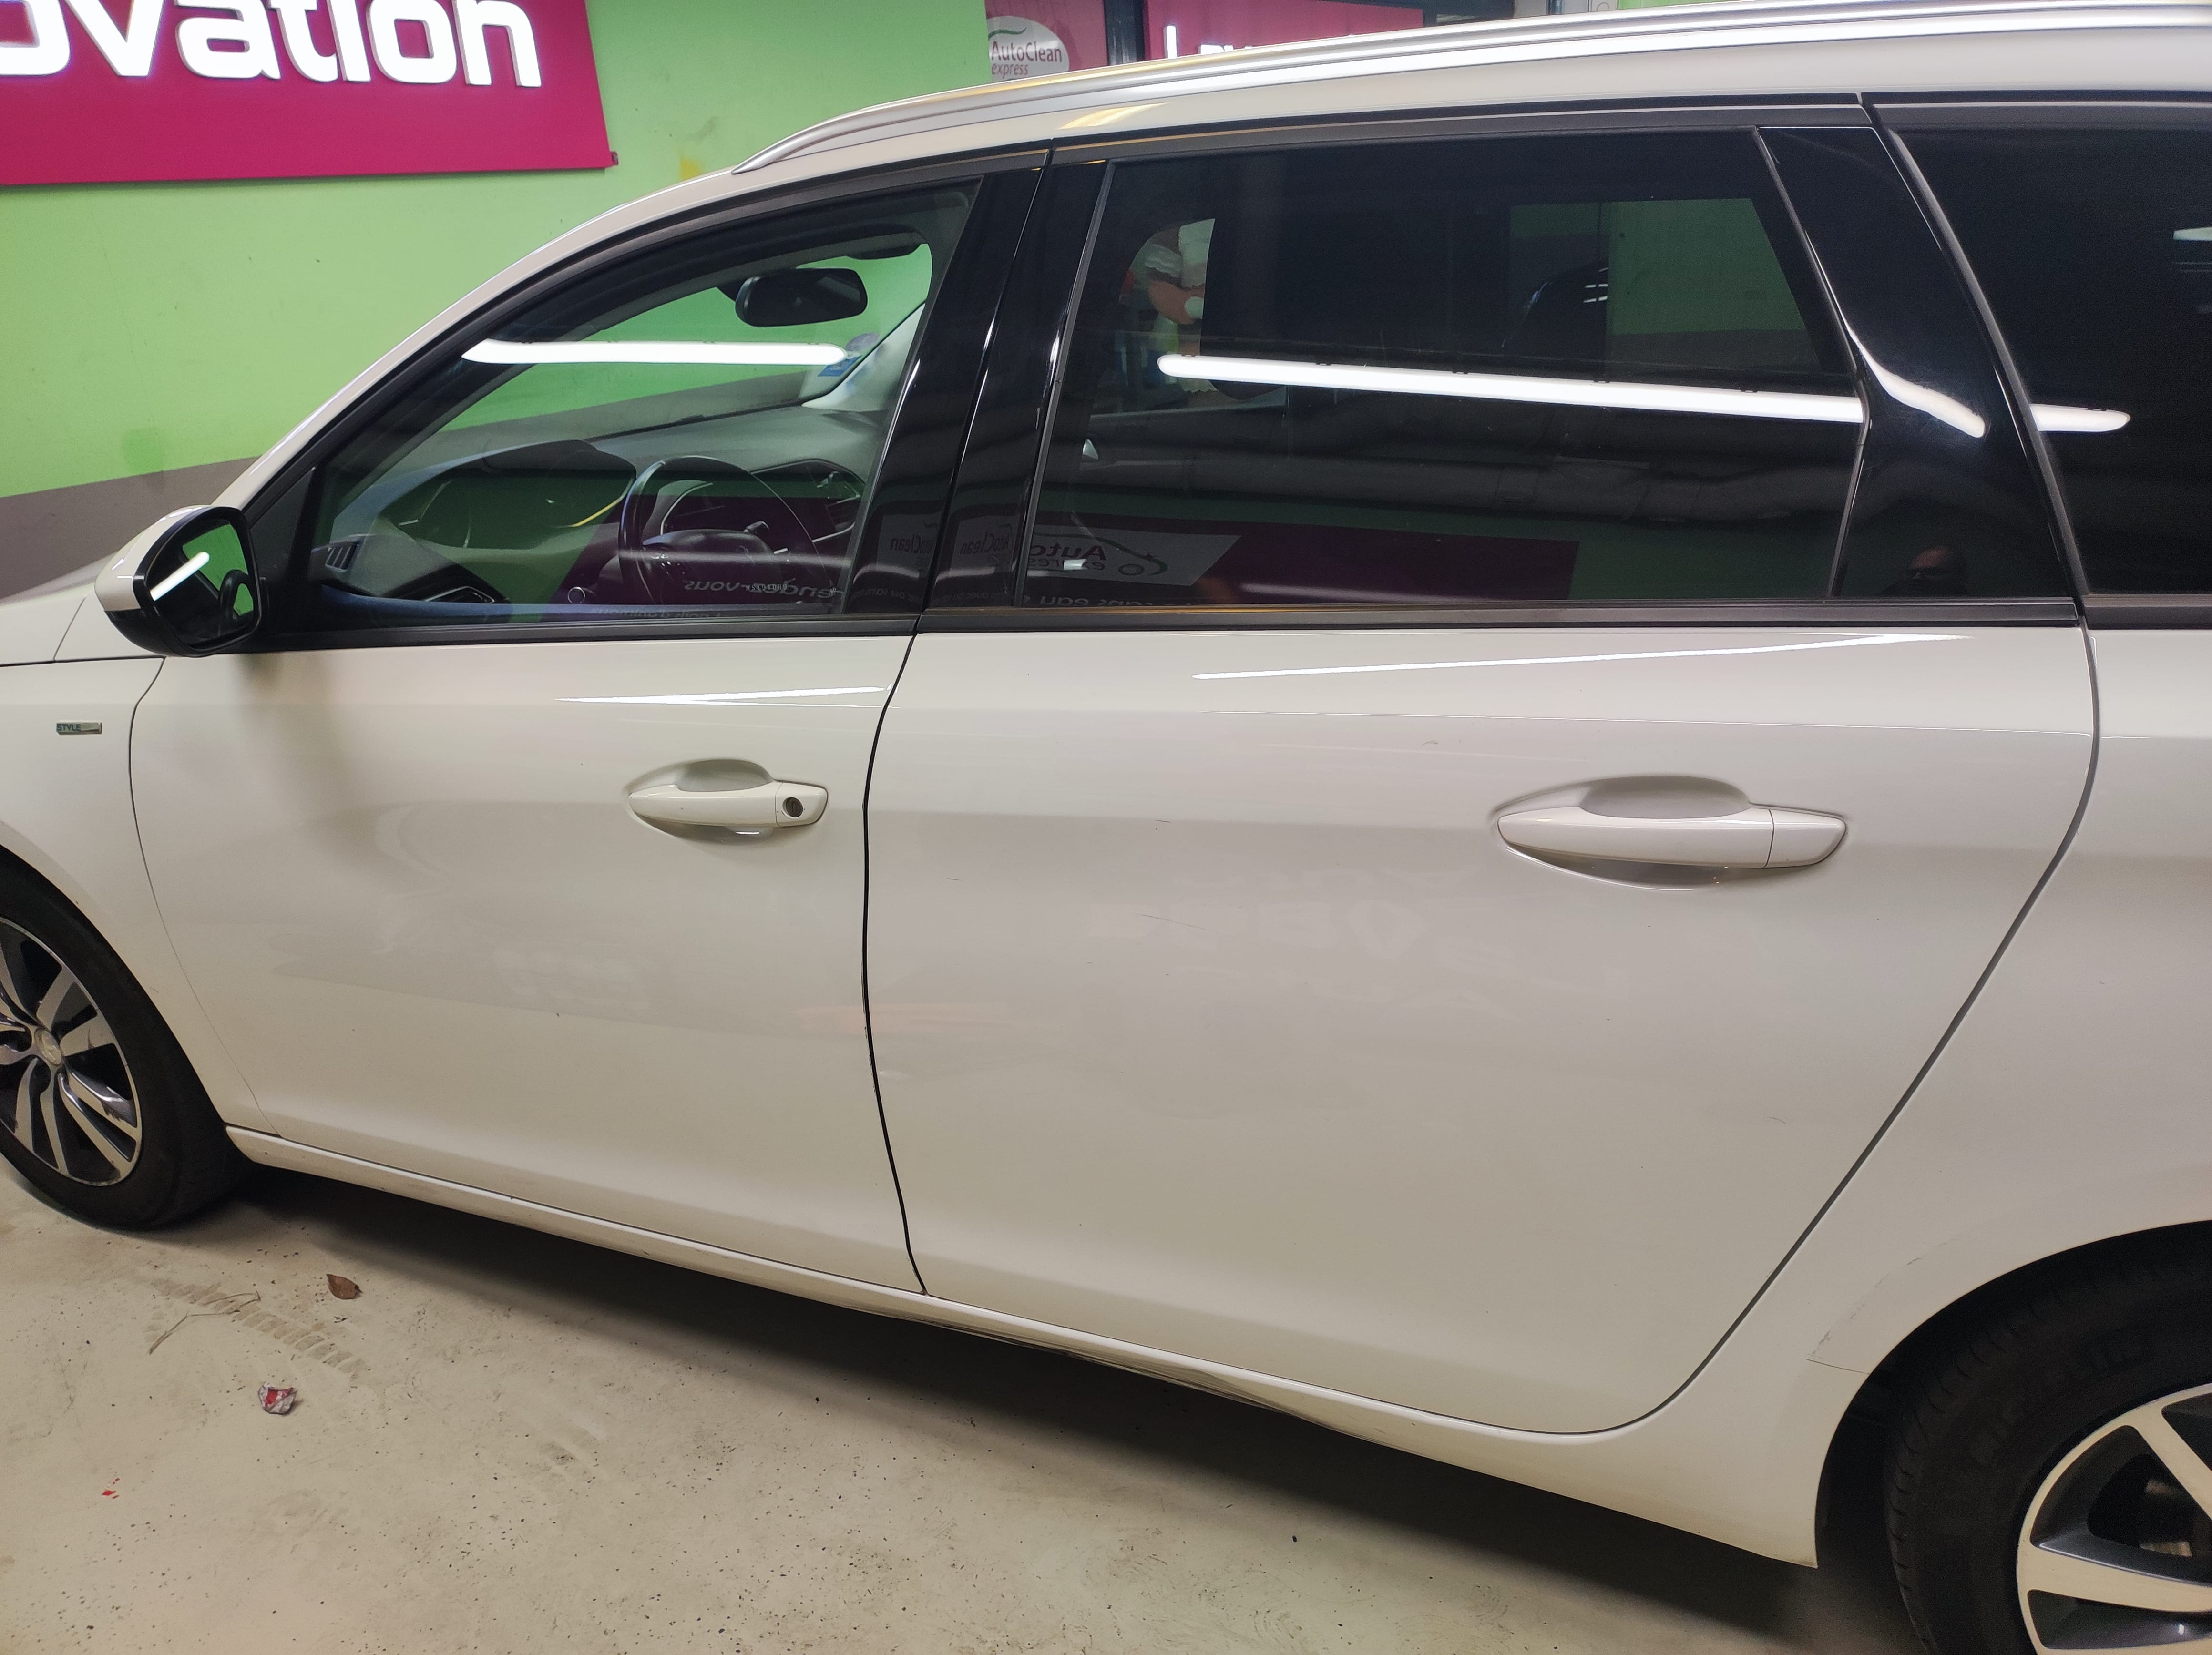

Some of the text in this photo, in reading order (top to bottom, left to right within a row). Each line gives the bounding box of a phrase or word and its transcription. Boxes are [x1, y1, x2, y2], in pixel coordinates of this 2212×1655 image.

[991, 41, 1062, 62] AutoClean
[991, 63, 1028, 79] express
[57, 723, 81, 731] STYLE
